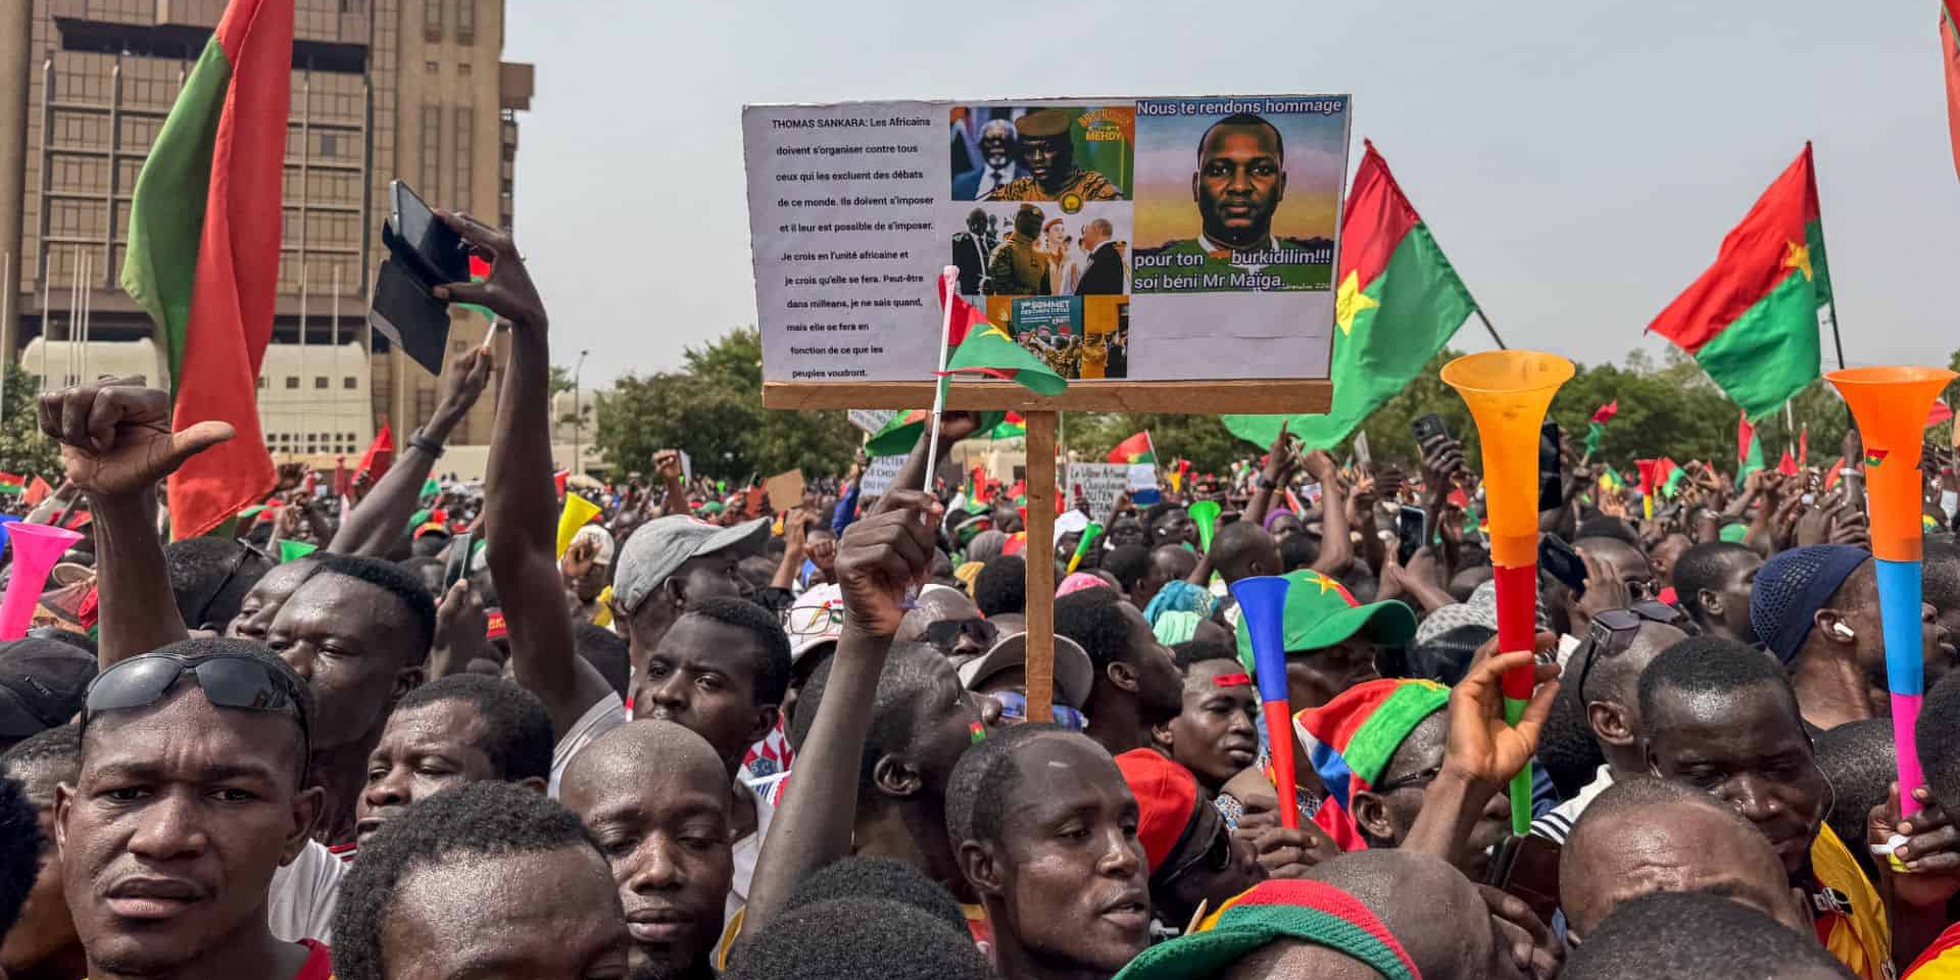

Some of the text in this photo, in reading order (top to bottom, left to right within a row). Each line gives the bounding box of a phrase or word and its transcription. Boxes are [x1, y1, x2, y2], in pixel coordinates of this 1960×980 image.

[1136, 100, 1342, 115] Nous te rendons hommage
[772, 116, 931, 129] THOMAS SANKARA: Les Africains
[776, 145, 918, 156] doivent s'organiser contre tous
[775, 169, 924, 183] ceux qui les excluent des débats
[777, 198, 790, 207] de
[804, 197, 838, 207] monde.
[853, 196, 887, 206] doivent
[890, 196, 934, 206] s'imposer
[779, 221, 934, 233] et il leur est possible de s'imposer.
[780, 253, 792, 261] Je
[794, 252, 816, 261] crois
[830, 251, 858, 260] l'unité
[859, 251, 897, 260] africaine
[900, 251, 909, 259] et
[1134, 249, 1331, 270] pour ton burkidilim!!!
[785, 276, 794, 286] je
[795, 276, 817, 285] crois
[818, 275, 847, 286] qu'elle
[861, 275, 881, 284] fera.
[883, 274, 924, 283] Peut-être
[1134, 273, 1159, 290] soi
[1163, 274, 1198, 289] béni
[1203, 273, 1225, 288] Mr
[1229, 273, 1284, 289] Maïga.
[787, 300, 809, 308] dans
[850, 300, 859, 310] je
[873, 298, 891, 307] sais
[893, 297, 923, 309] quand,
[786, 323, 808, 332] mais
[809, 323, 825, 331] elle
[839, 322, 856, 331] fera
[790, 346, 826, 355] fonction
[827, 345, 839, 355] de
[852, 346, 869, 356] que
[870, 345, 883, 354] les
[792, 368, 868, 379] peuples voudront.
